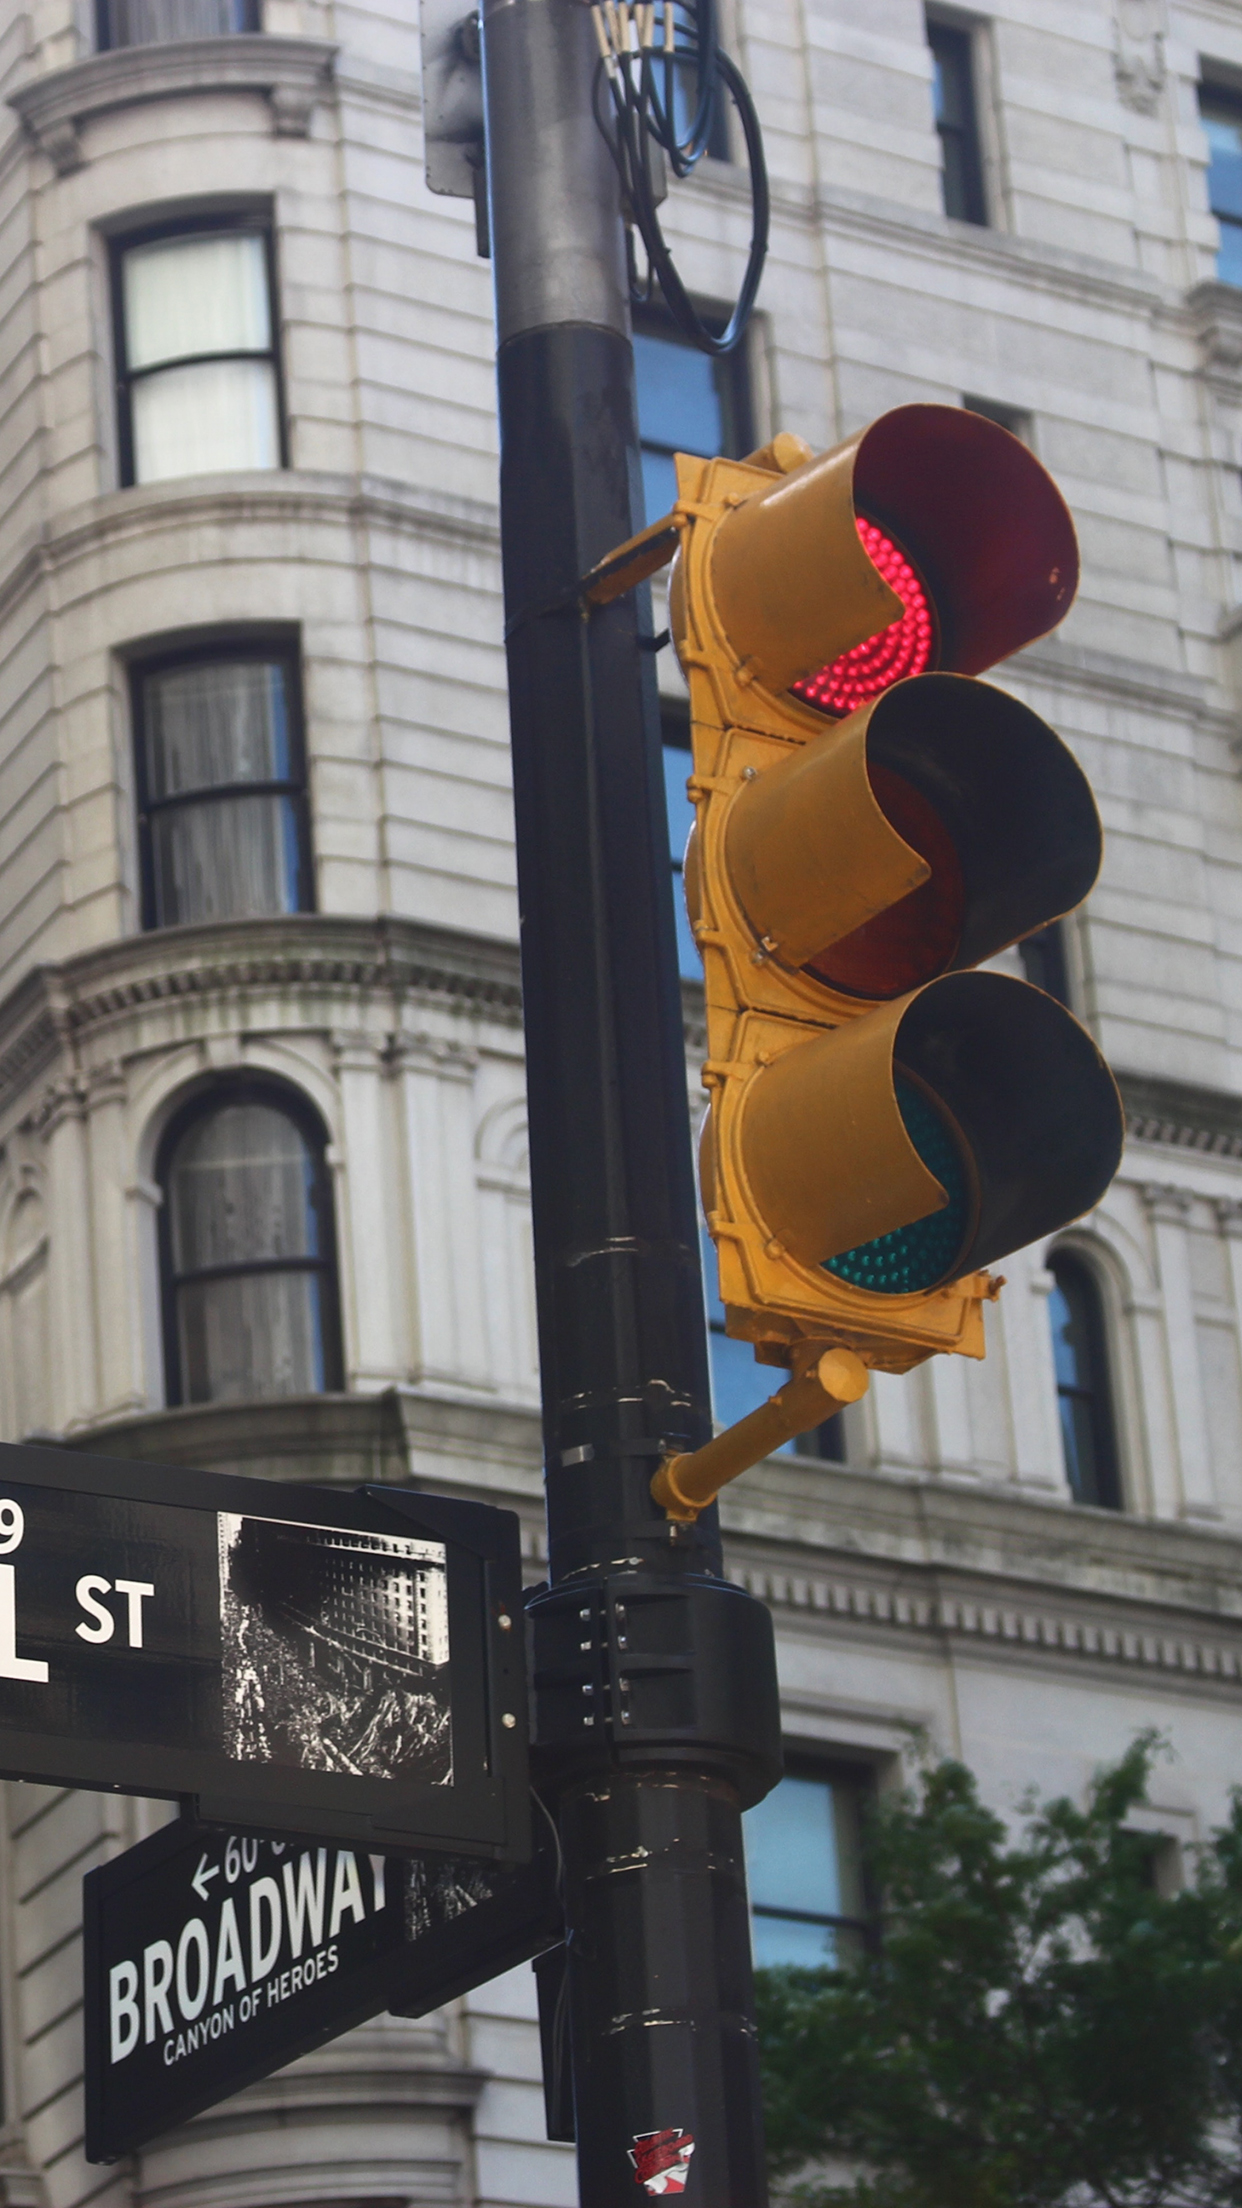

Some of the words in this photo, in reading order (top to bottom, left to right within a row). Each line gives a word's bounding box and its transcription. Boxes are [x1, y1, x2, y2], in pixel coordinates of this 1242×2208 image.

[75, 1574, 155, 1648] ST
[109, 1847, 386, 2065] BROADWAY
[163, 2004, 235, 2066] CANYON
[239, 1988, 262, 2023] OF
[267, 1944, 339, 2008] HEROES
